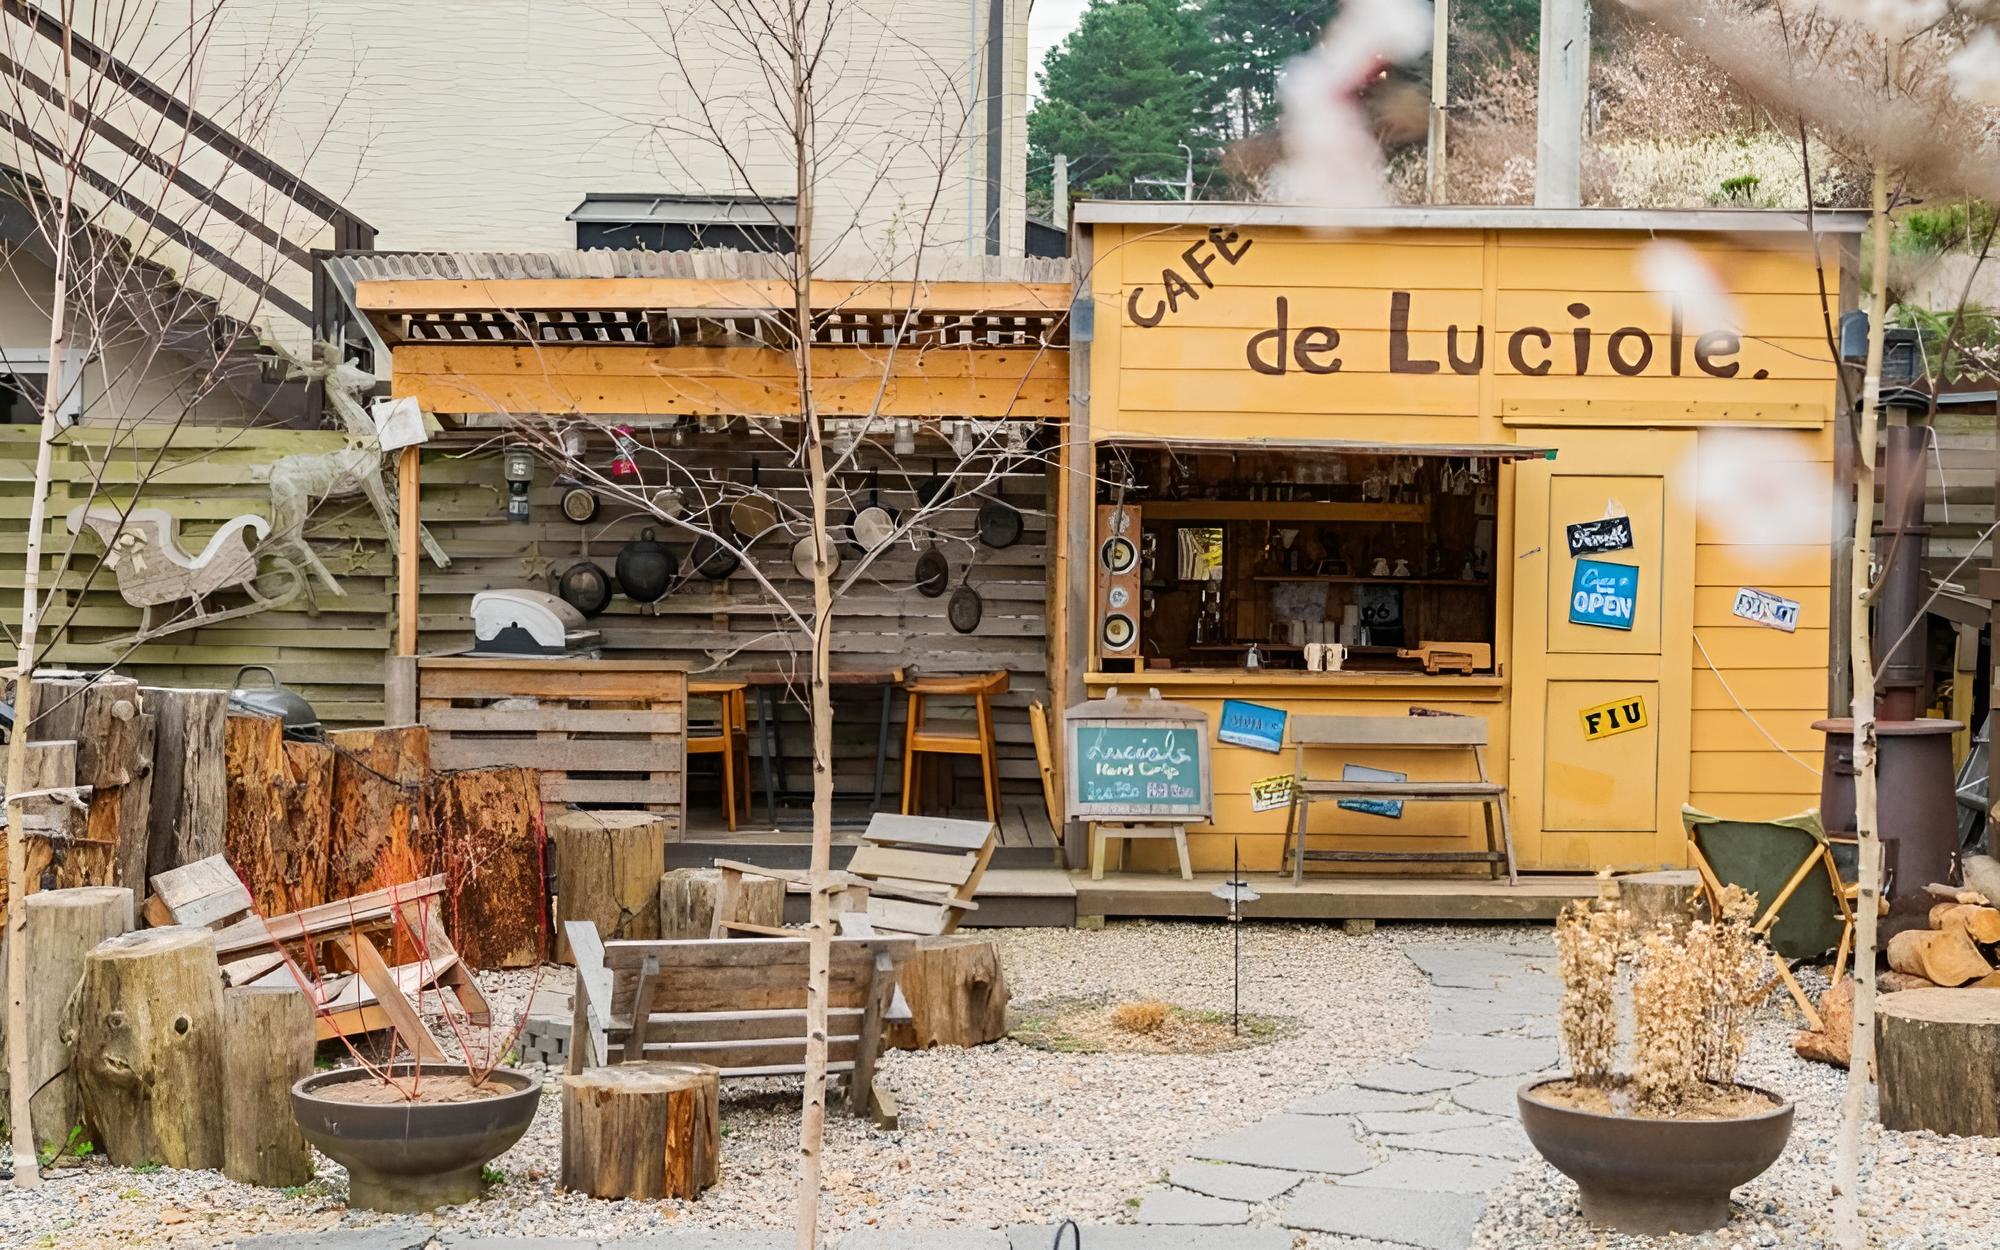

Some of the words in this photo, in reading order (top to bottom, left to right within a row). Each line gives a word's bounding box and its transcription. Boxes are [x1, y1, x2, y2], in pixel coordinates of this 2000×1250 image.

[1247, 296, 1341, 376] de
[1389, 291, 1769, 380] Luciole.
[1574, 591, 1632, 618] OPEN
[1585, 702, 1641, 735] FIU
